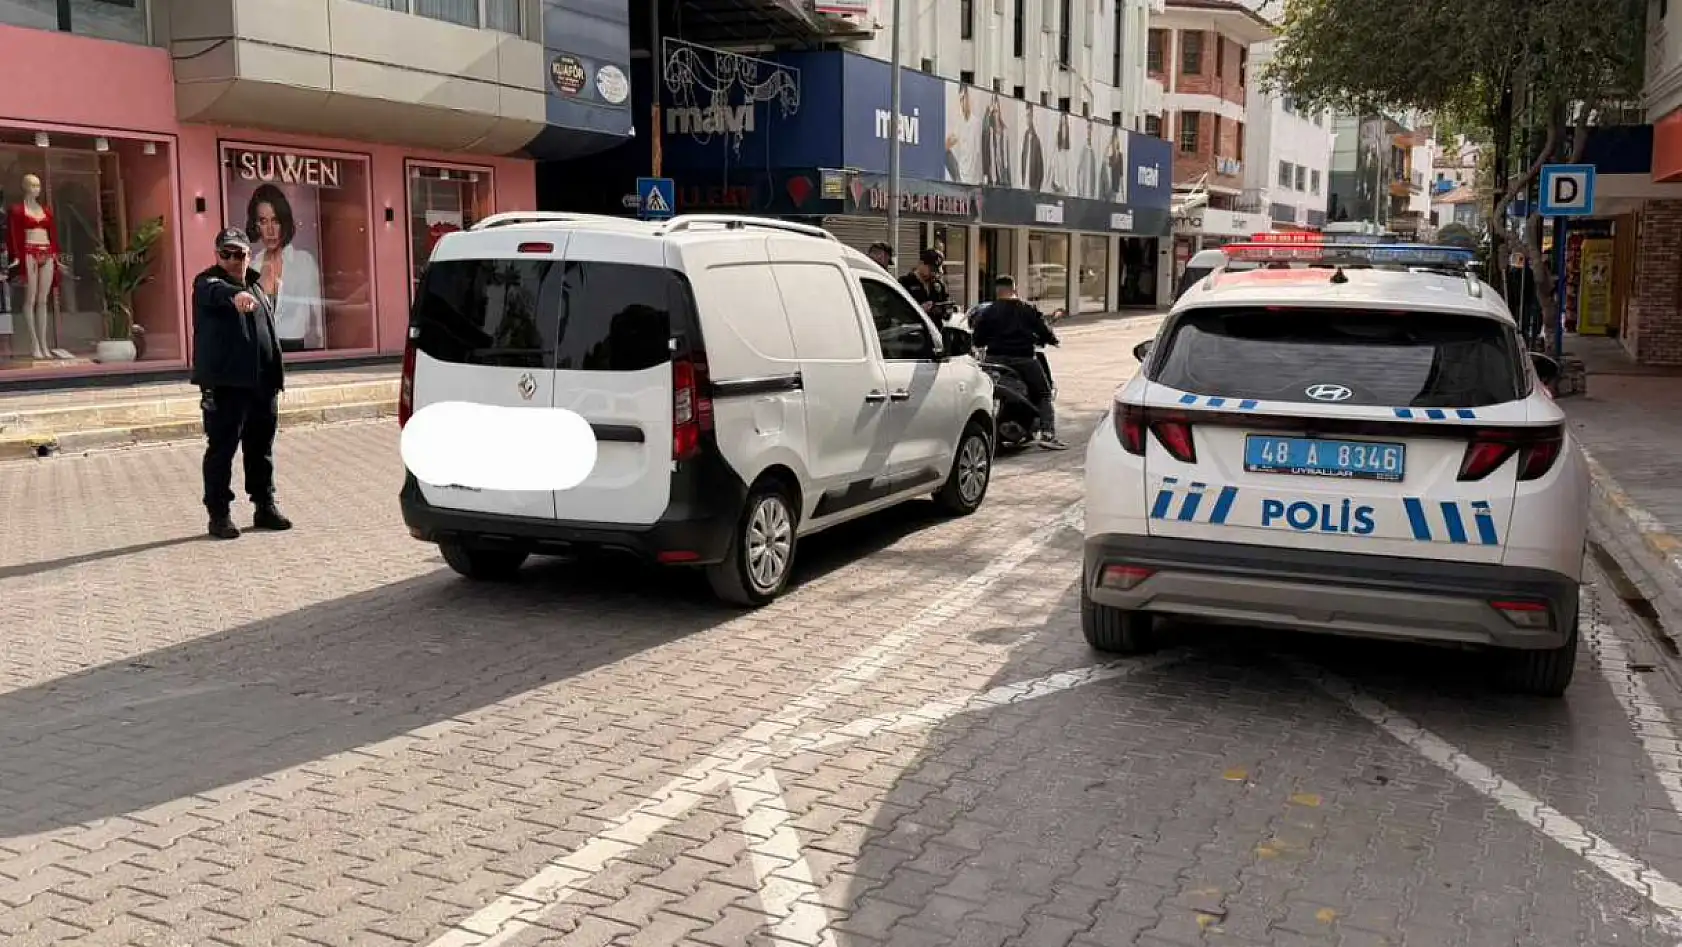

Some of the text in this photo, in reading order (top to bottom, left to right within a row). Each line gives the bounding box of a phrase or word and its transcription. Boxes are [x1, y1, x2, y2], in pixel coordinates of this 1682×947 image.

[666, 98, 754, 134] mavi
[241, 152, 338, 187] SUWEN
[1554, 177, 1578, 204] D
[1262, 441, 1396, 470] 48 A 8346
[1261, 498, 1376, 534] POLİS
